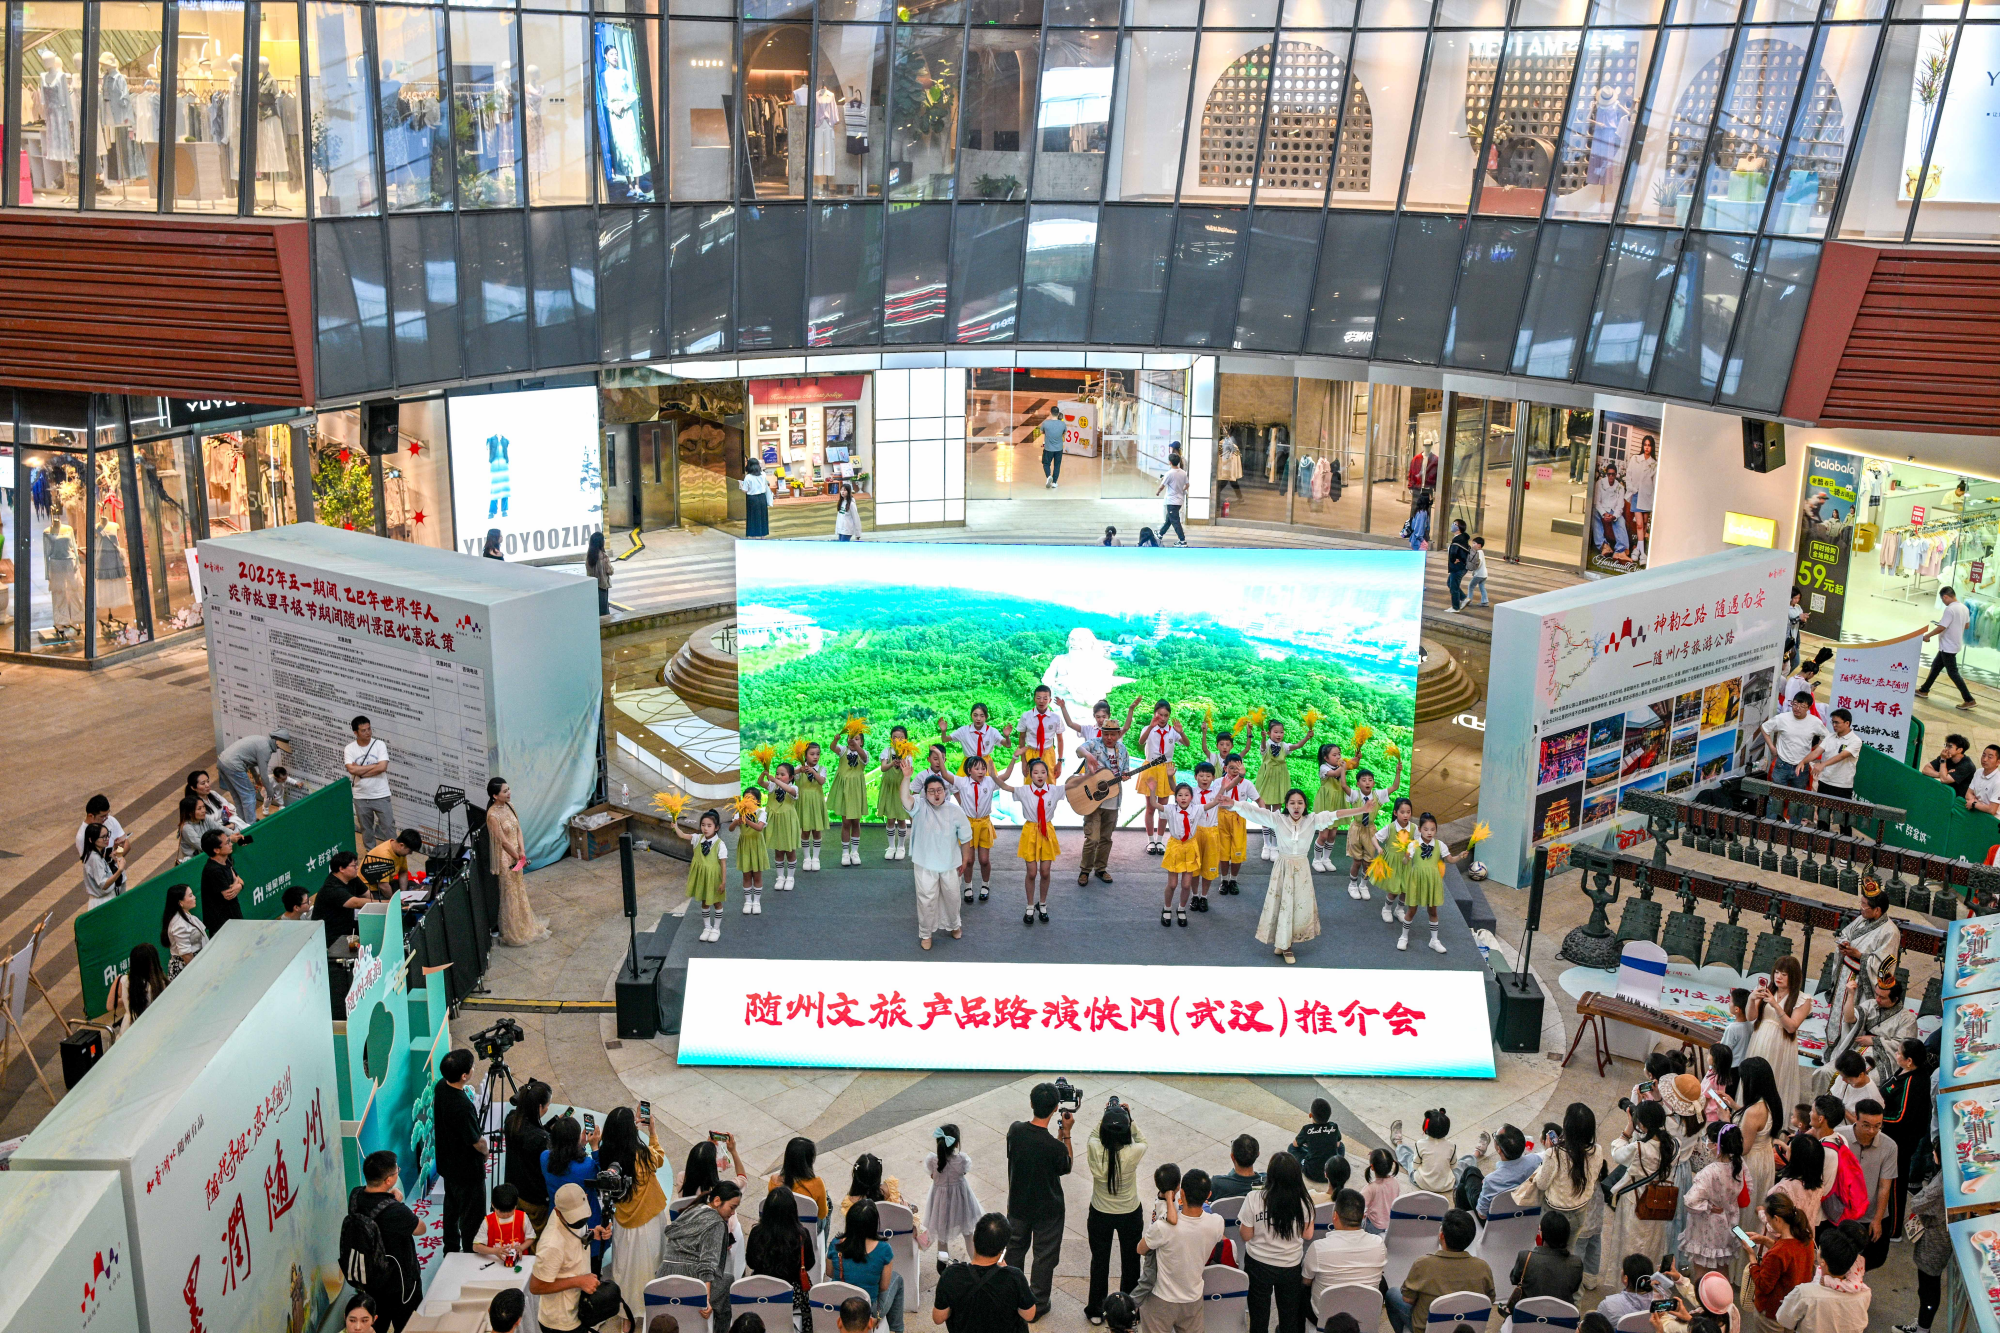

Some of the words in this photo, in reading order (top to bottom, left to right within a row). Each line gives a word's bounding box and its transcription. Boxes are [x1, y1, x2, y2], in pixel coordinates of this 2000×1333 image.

[1814, 456, 1856, 475] balabala
[1728, 522, 1769, 541] balabala
[1812, 550, 1836, 563] 全场商品
[1813, 543, 1837, 555] 限时抢购
[238, 561, 440, 624] 2025年五一期间、乙巳年世界华人
[228, 583, 456, 653] 炎帝故里寻根节期间随州景区优惠政策
[1653, 604, 1708, 636] 神韵之路
[1714, 588, 1766, 619] 随遇而安
[1837, 696, 1903, 717] 随州有乐
[744, 990, 1427, 1038] 随州文旅产品路演快闪(武汉)推介会
